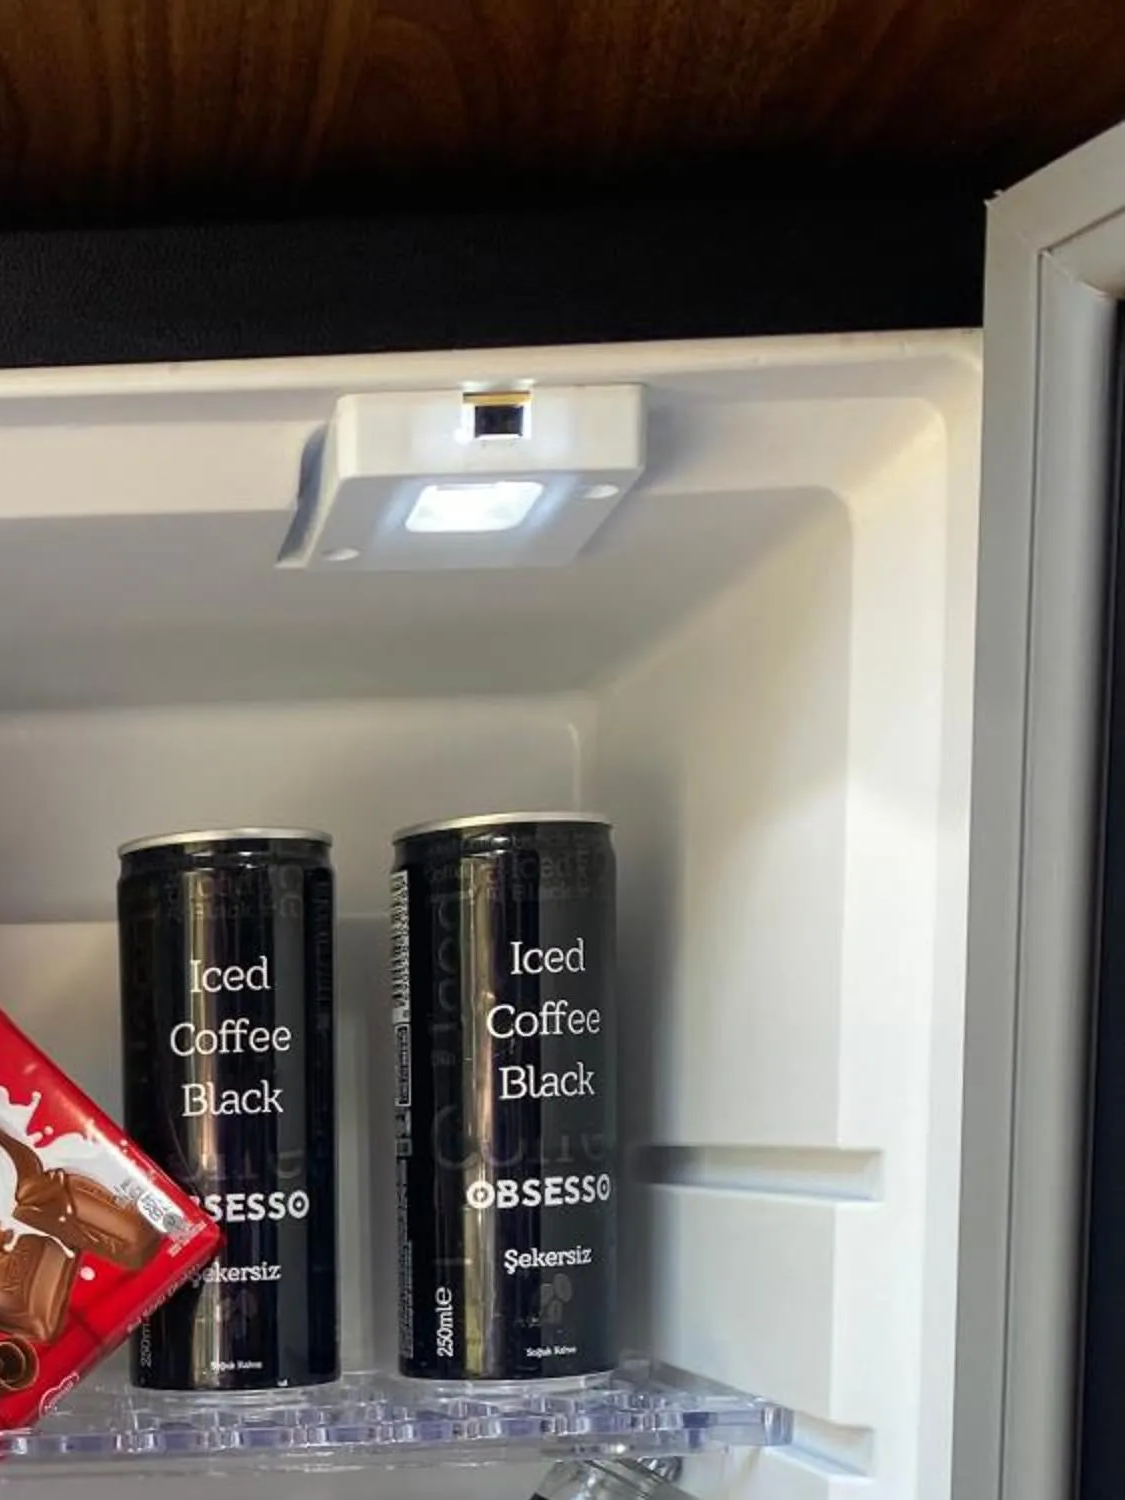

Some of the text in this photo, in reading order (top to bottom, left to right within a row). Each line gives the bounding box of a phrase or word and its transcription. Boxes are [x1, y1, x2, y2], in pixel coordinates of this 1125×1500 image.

[190, 955, 271, 993] Iced
[510, 937, 586, 975] Iced
[170, 1018, 292, 1057] Coffee
[487, 1000, 601, 1039] Coffee
[181, 1079, 284, 1117] Black
[498, 1062, 595, 1100] Black
[190, 1189, 310, 1223] SESSO
[466, 1173, 612, 1209] OBSESSO
[503, 1245, 593, 1275] Şekersiz
